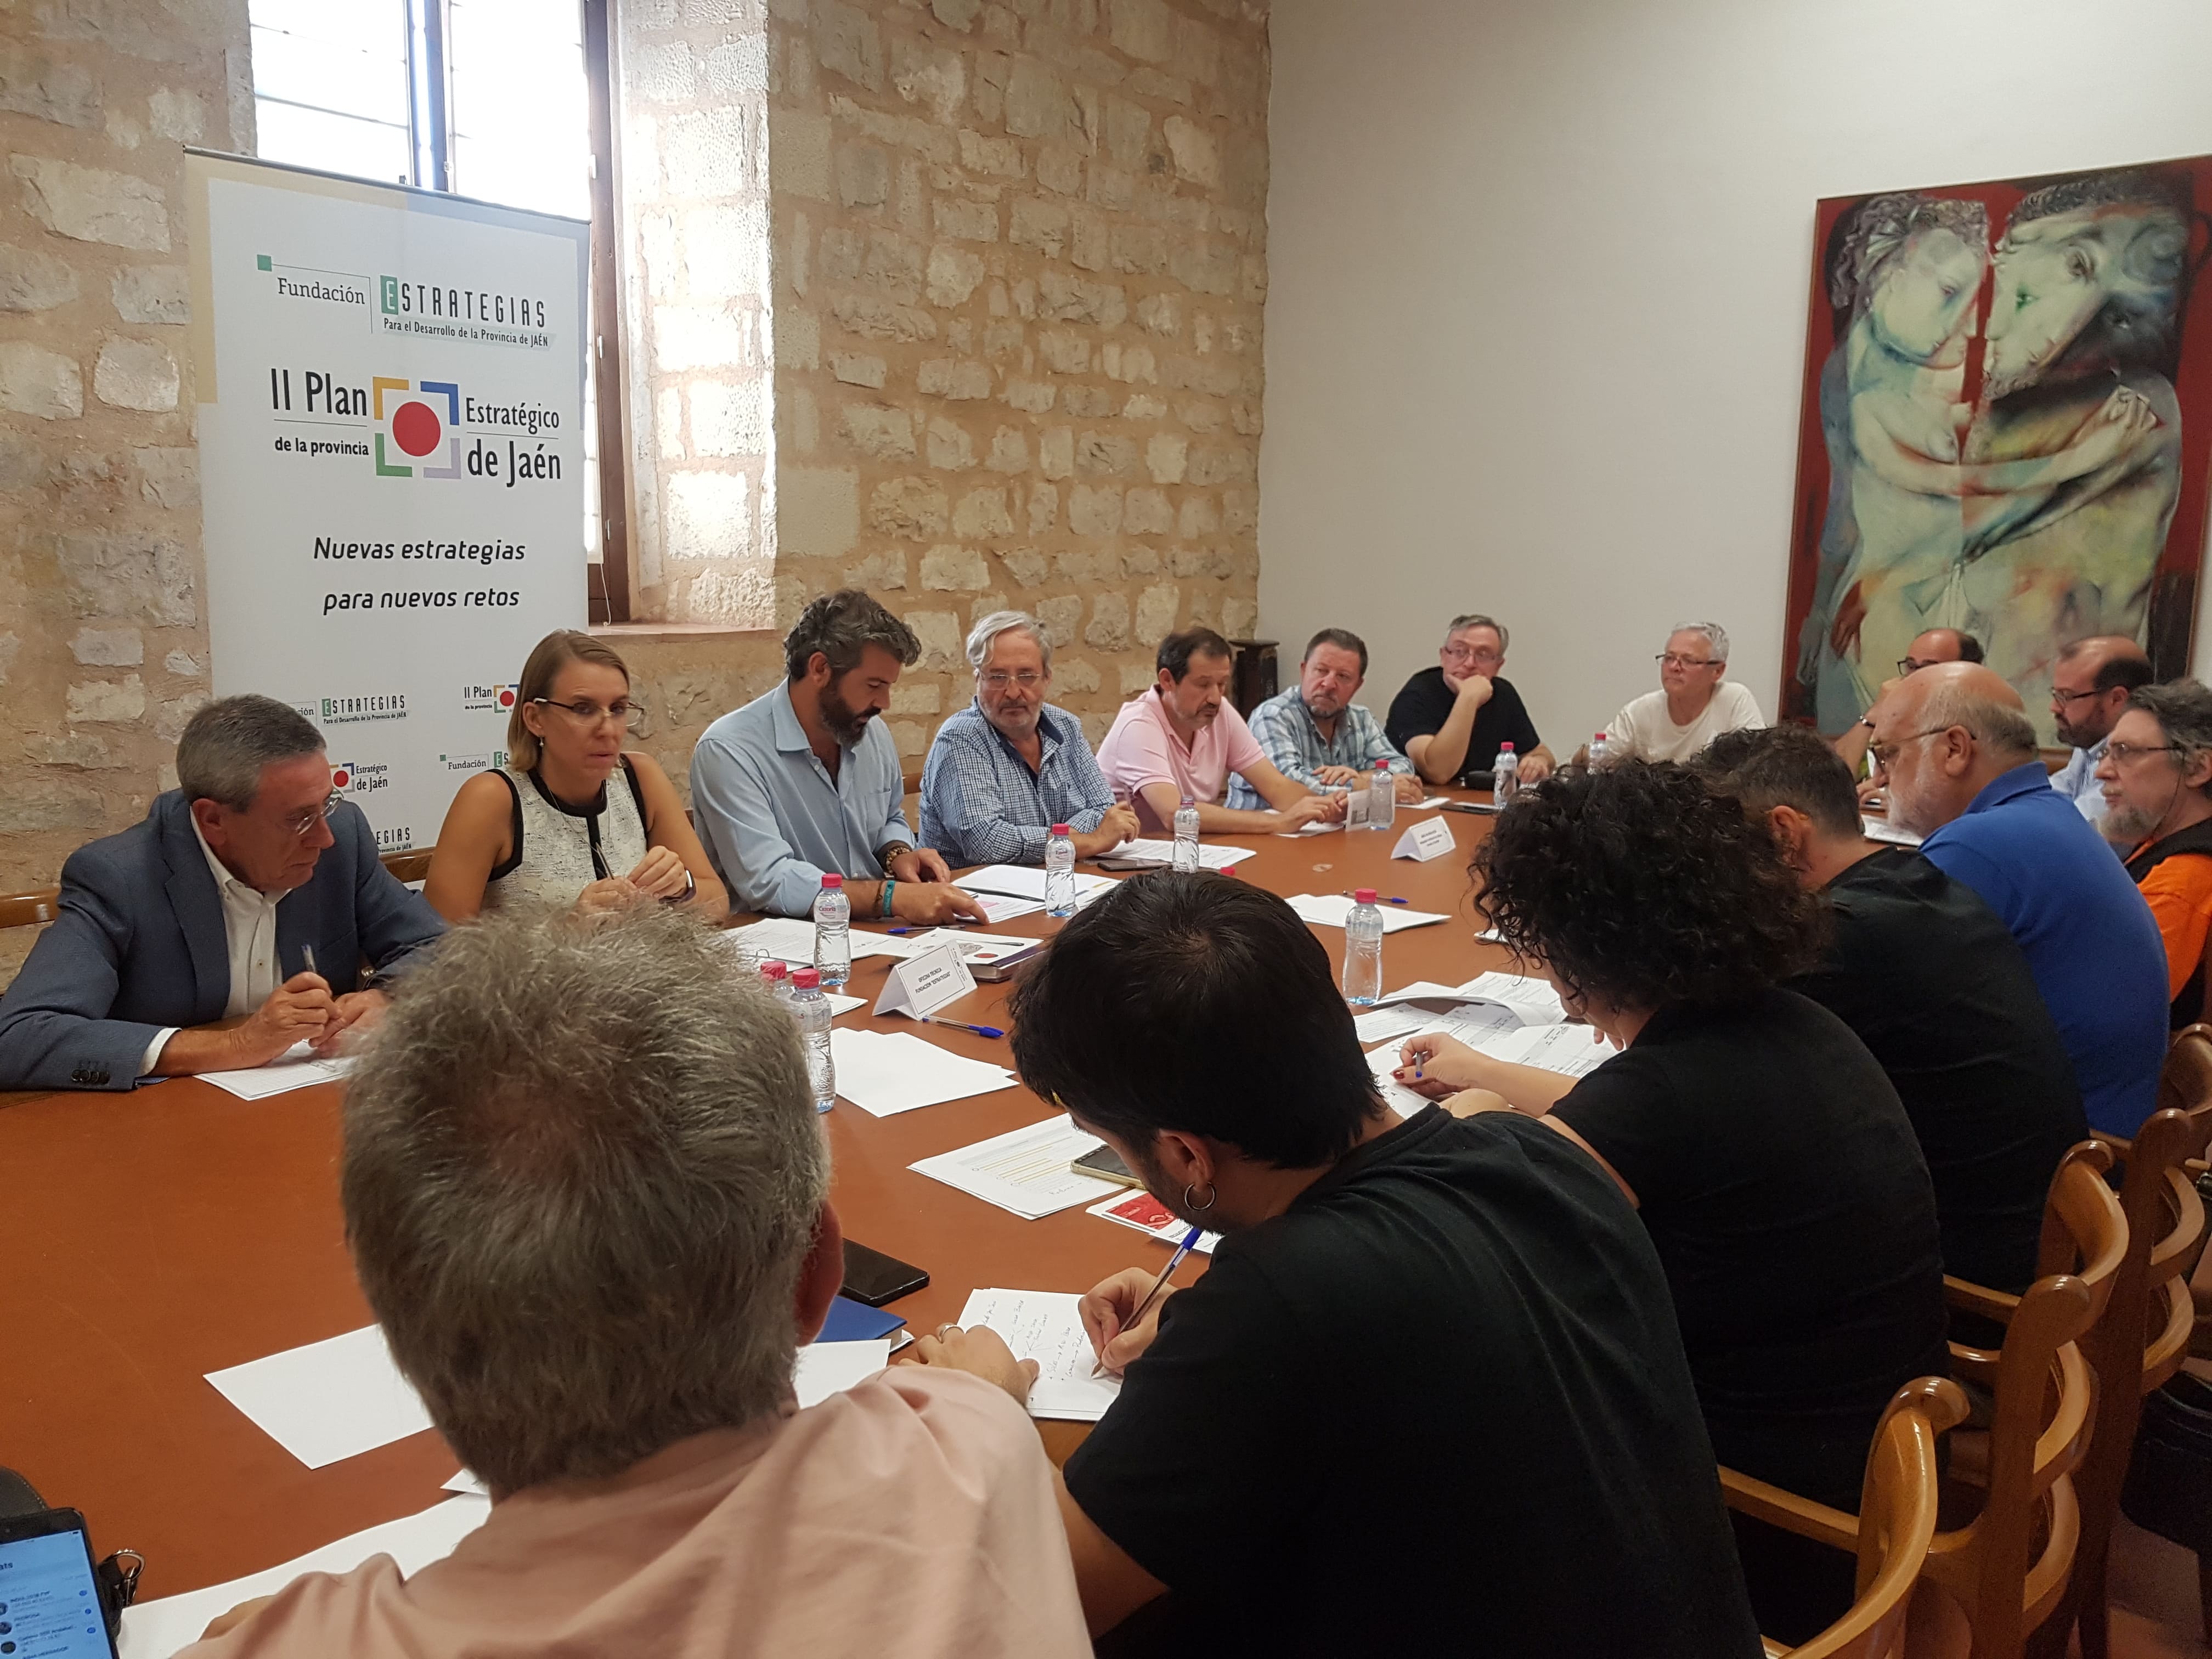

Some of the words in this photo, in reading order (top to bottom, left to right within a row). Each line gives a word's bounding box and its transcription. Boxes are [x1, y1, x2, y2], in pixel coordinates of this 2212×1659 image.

[278, 277, 365, 304] Fundación
[385, 280, 545, 328] ESTRATEGIAS
[384, 318, 402, 331] Para
[404, 321, 411, 331] el
[414, 322, 455, 336] Desarrollo
[458, 327, 467, 337] de
[471, 328, 478, 339] la
[482, 330, 517, 344] Provincia
[519, 333, 528, 345] de
[531, 334, 548, 348] JAÉN
[271, 368, 291, 410] II
[306, 371, 367, 416] Plan
[466, 397, 559, 435] Estratégico
[274, 437, 291, 452] de
[295, 438, 307, 453] la
[311, 440, 369, 456] provincia
[467, 439, 498, 477] de
[506, 441, 561, 488] Jaén
[313, 537, 394, 559] Nuevas
[401, 539, 526, 565] estrategias
[323, 592, 373, 616] para
[381, 592, 457, 608] nuevos
[464, 588, 520, 606] retos
[324, 695, 405, 716] ESTRATEGIAS
[473, 686, 492, 698] Plan
[357, 763, 387, 774] Estratégico
[448, 760, 487, 770] Fundación
[357, 778, 366, 790] de
[369, 776, 388, 792] Jaén
